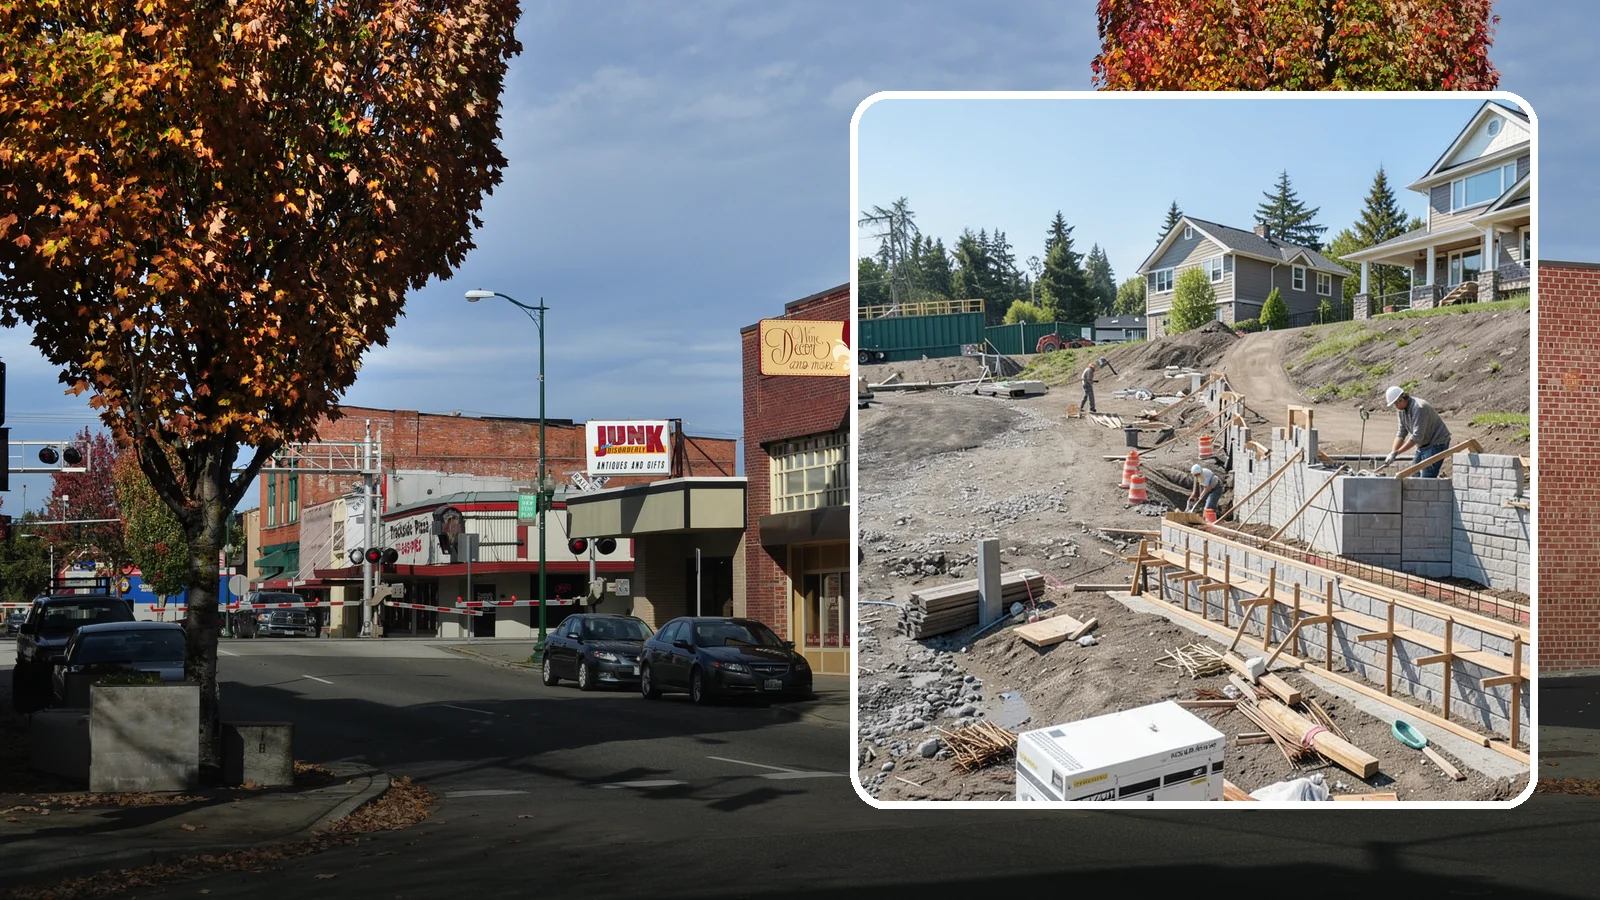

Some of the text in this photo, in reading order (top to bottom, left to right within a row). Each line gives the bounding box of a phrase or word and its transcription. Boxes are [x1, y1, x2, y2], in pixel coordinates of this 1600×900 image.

[595, 425, 665, 457] JUNK
[607, 445, 646, 454] DISORDERLY
[596, 460, 665, 470] ANTIQUES AND GIFTS
[414, 519, 429, 534] Pizza
